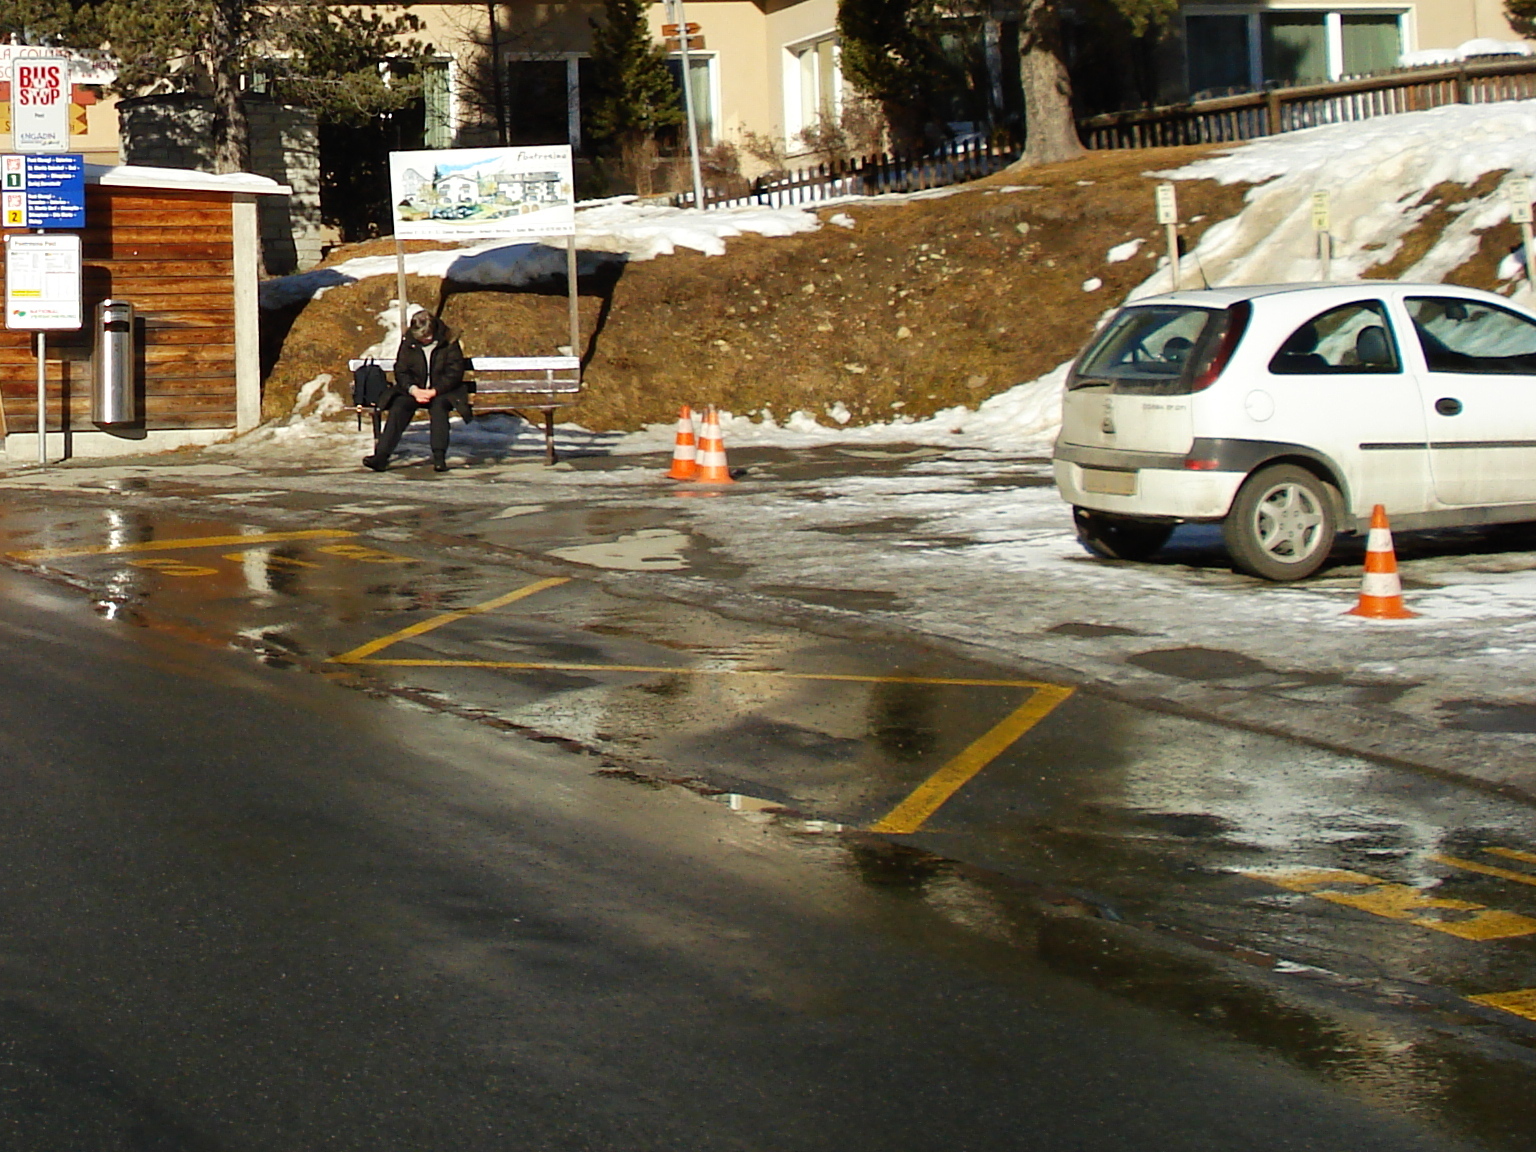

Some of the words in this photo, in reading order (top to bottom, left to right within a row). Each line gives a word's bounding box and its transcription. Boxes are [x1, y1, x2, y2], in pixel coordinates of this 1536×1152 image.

[19, 66, 60, 88] BUS
[19, 88, 60, 105] STOP
[10, 174, 17, 186] 1
[11, 212, 18, 222] 2
